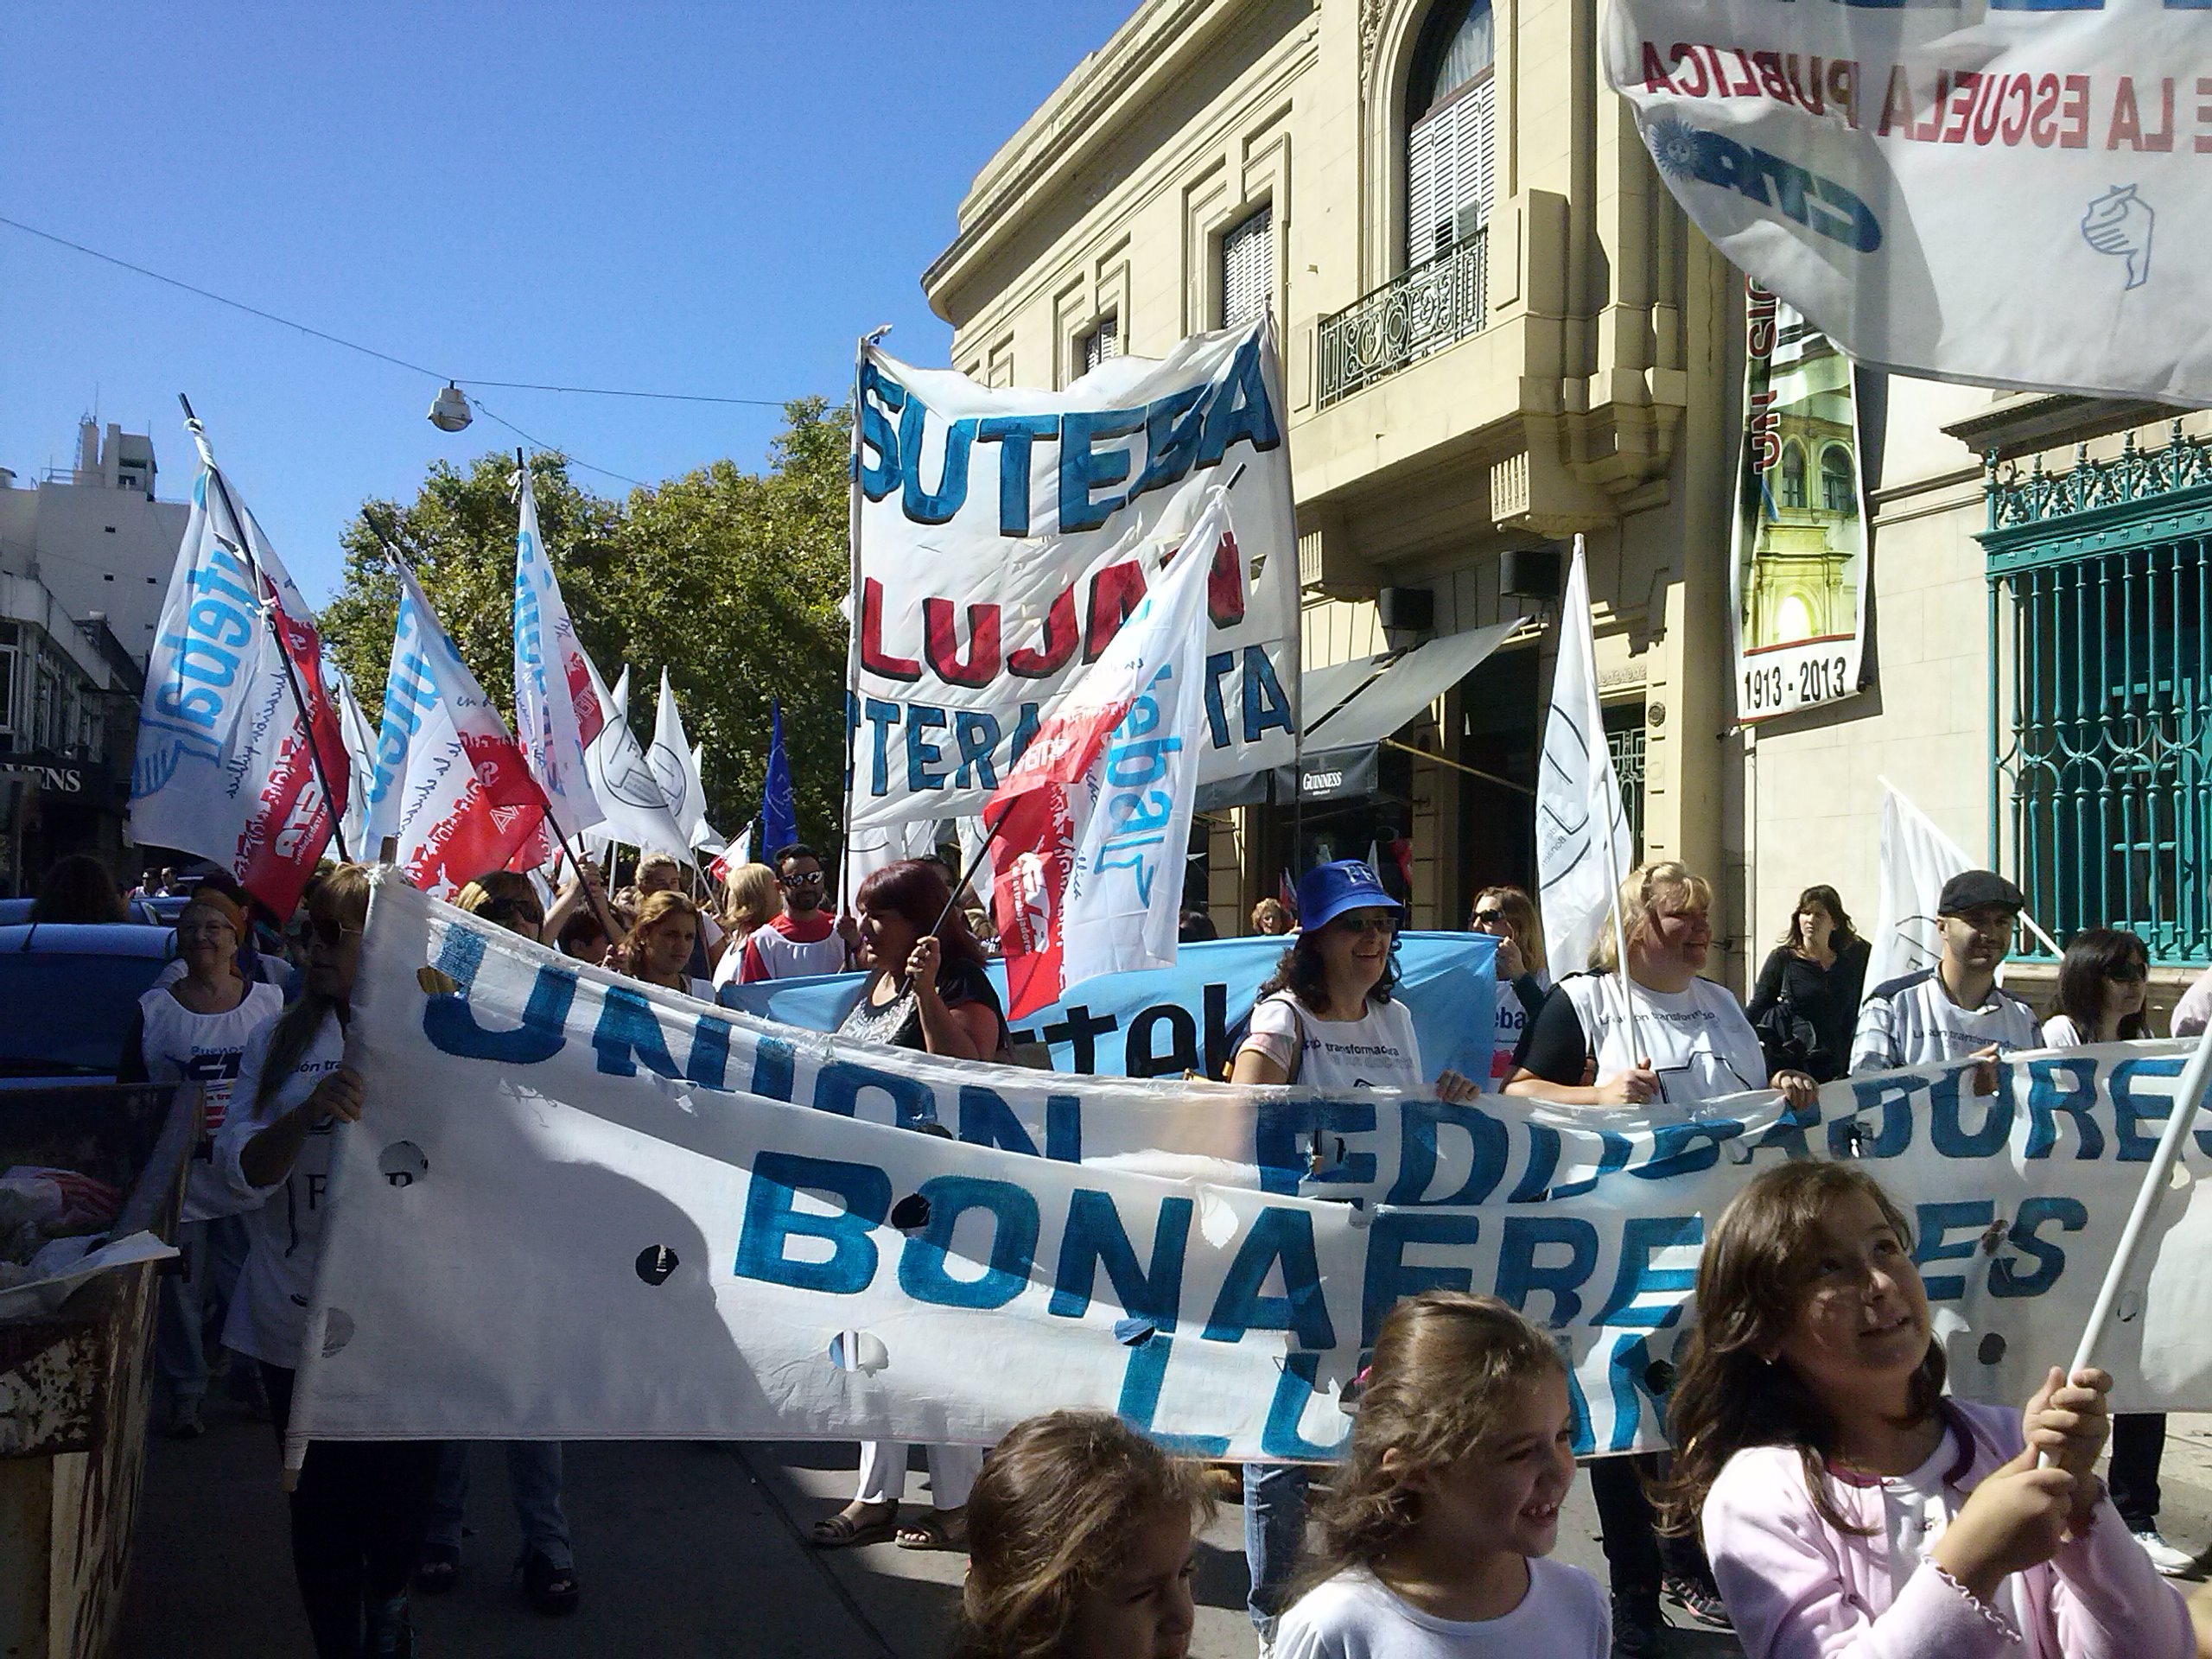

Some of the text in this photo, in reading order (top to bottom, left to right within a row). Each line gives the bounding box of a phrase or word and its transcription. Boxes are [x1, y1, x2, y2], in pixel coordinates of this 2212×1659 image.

[863, 329, 1282, 537] SUTEBA
[1744, 666, 1782, 710] 1913
[1800, 657, 1847, 702] 2013
[1303, 771, 1343, 791] GUINNESS
